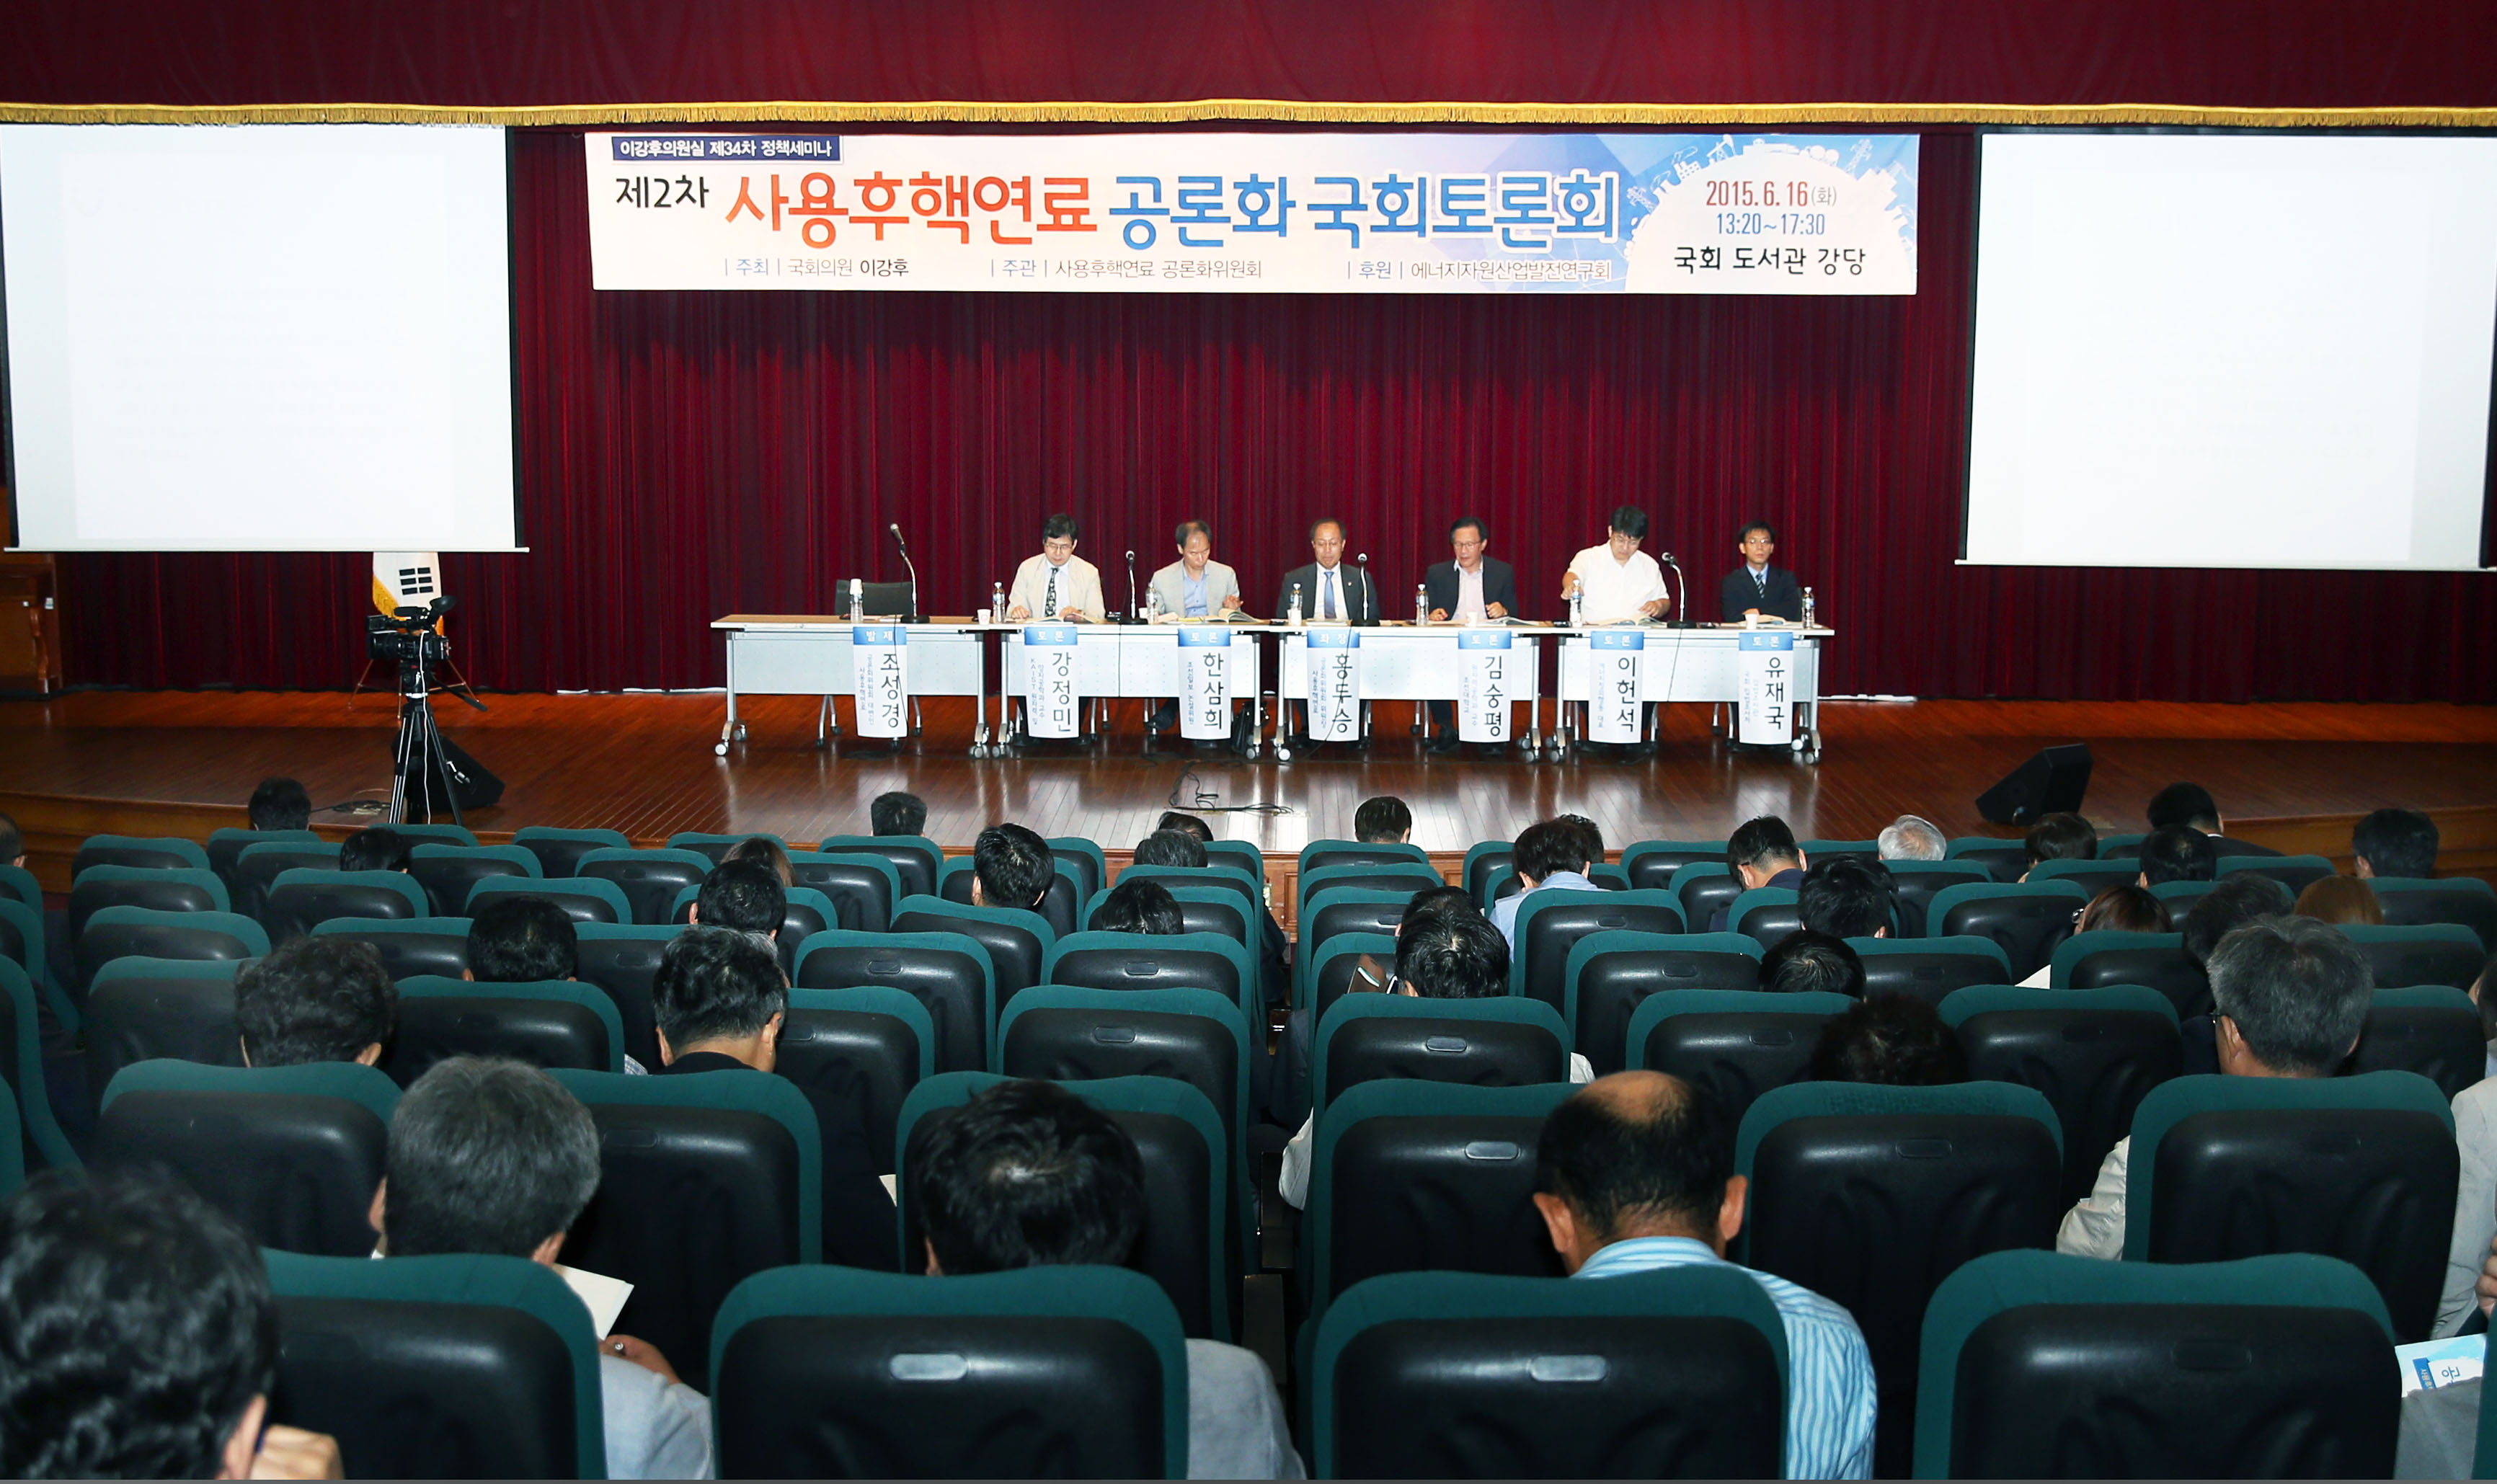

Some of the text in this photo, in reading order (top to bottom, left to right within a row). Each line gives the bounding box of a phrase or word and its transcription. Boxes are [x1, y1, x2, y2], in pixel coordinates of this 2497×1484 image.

[620, 140, 832, 157] 이강후의원실 제34차 정책세미나
[616, 172, 1614, 251] 제2차 사용후핵연료 공론화 국회토론회
[736, 258, 910, 277] 주최 국회의원 이강후
[1002, 259, 1262, 279] 주관 사용후핵연료 공론화위원회
[1358, 261, 1610, 280] 후원 에너지자원산업발전연구회
[1674, 246, 1866, 275] 국회 도서관 강당
[880, 653, 900, 728] 조성경
[1052, 652, 1072, 732] 강정민
[1202, 652, 1224, 730] 한삼희
[1331, 653, 1353, 733] 홍두승
[1483, 655, 1504, 737] 김숭평
[1616, 656, 1636, 732] 이헌석
[1764, 657, 1785, 730] 유재국
